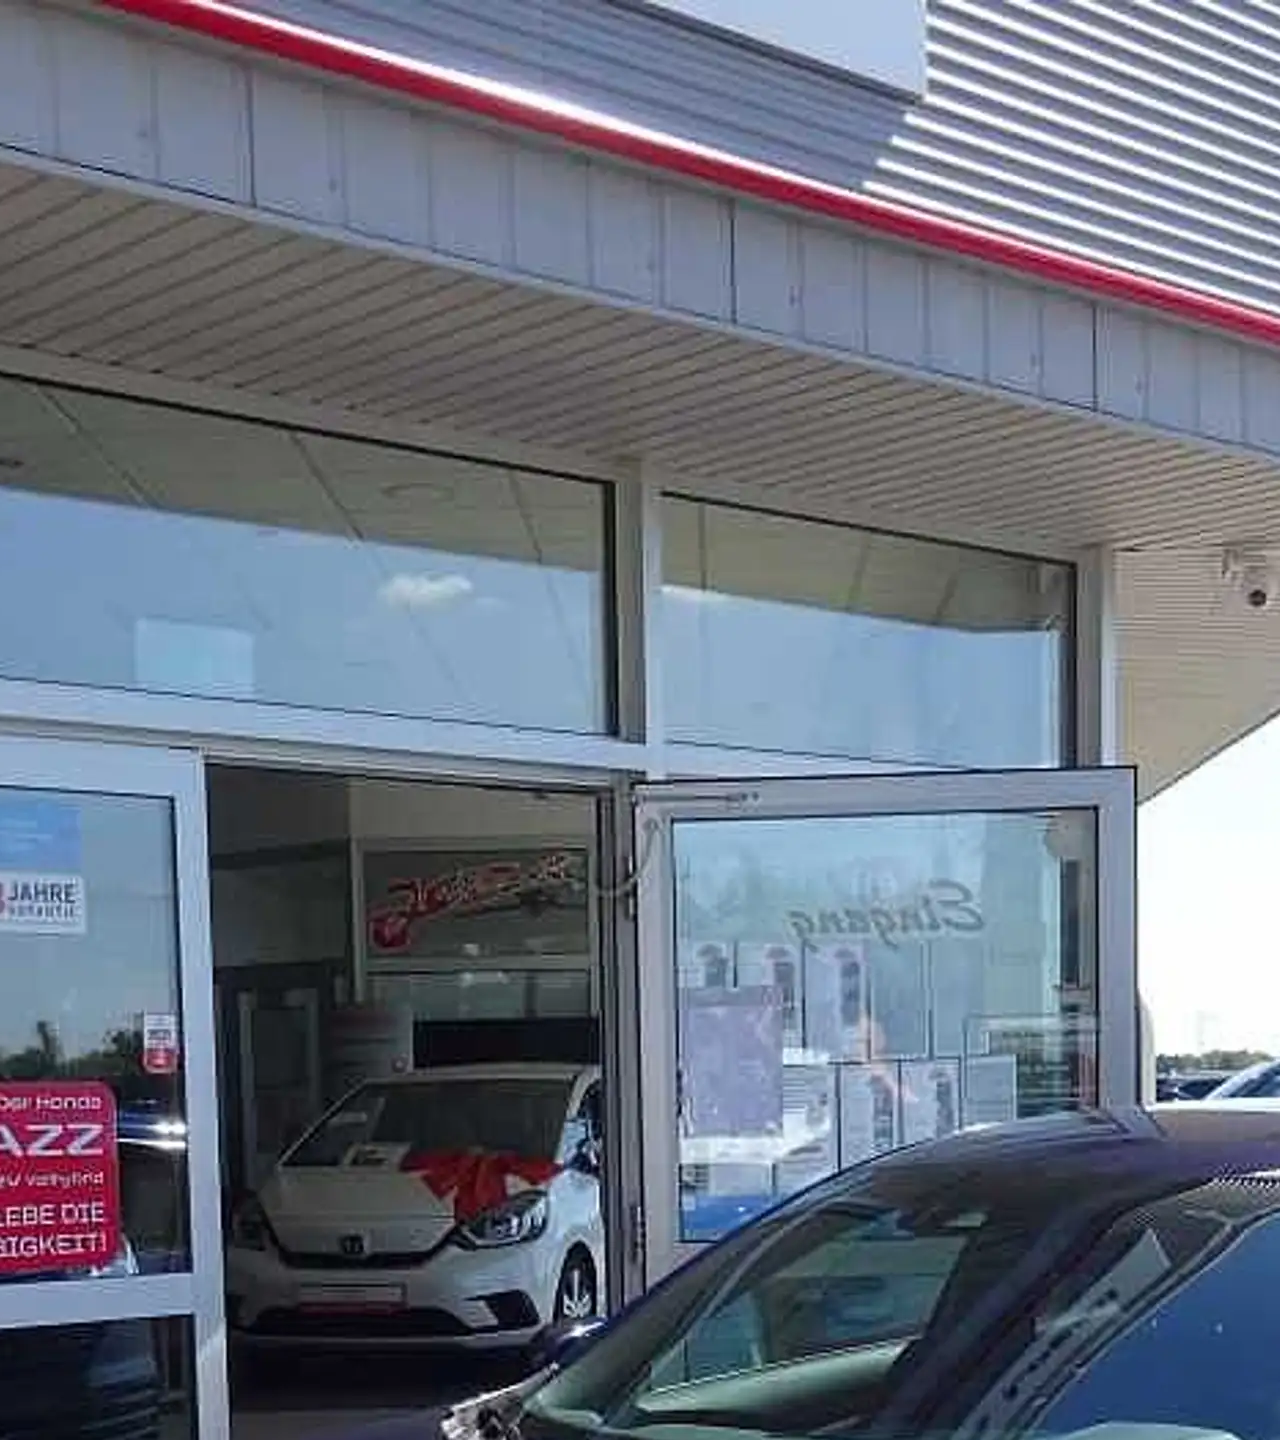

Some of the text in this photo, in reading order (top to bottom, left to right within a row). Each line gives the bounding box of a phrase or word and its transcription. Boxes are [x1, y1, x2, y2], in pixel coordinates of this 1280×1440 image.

[8, 882, 76, 903] JAHRE
[36, 1096, 102, 1110] Honda
[60, 1201, 105, 1223] DIE
